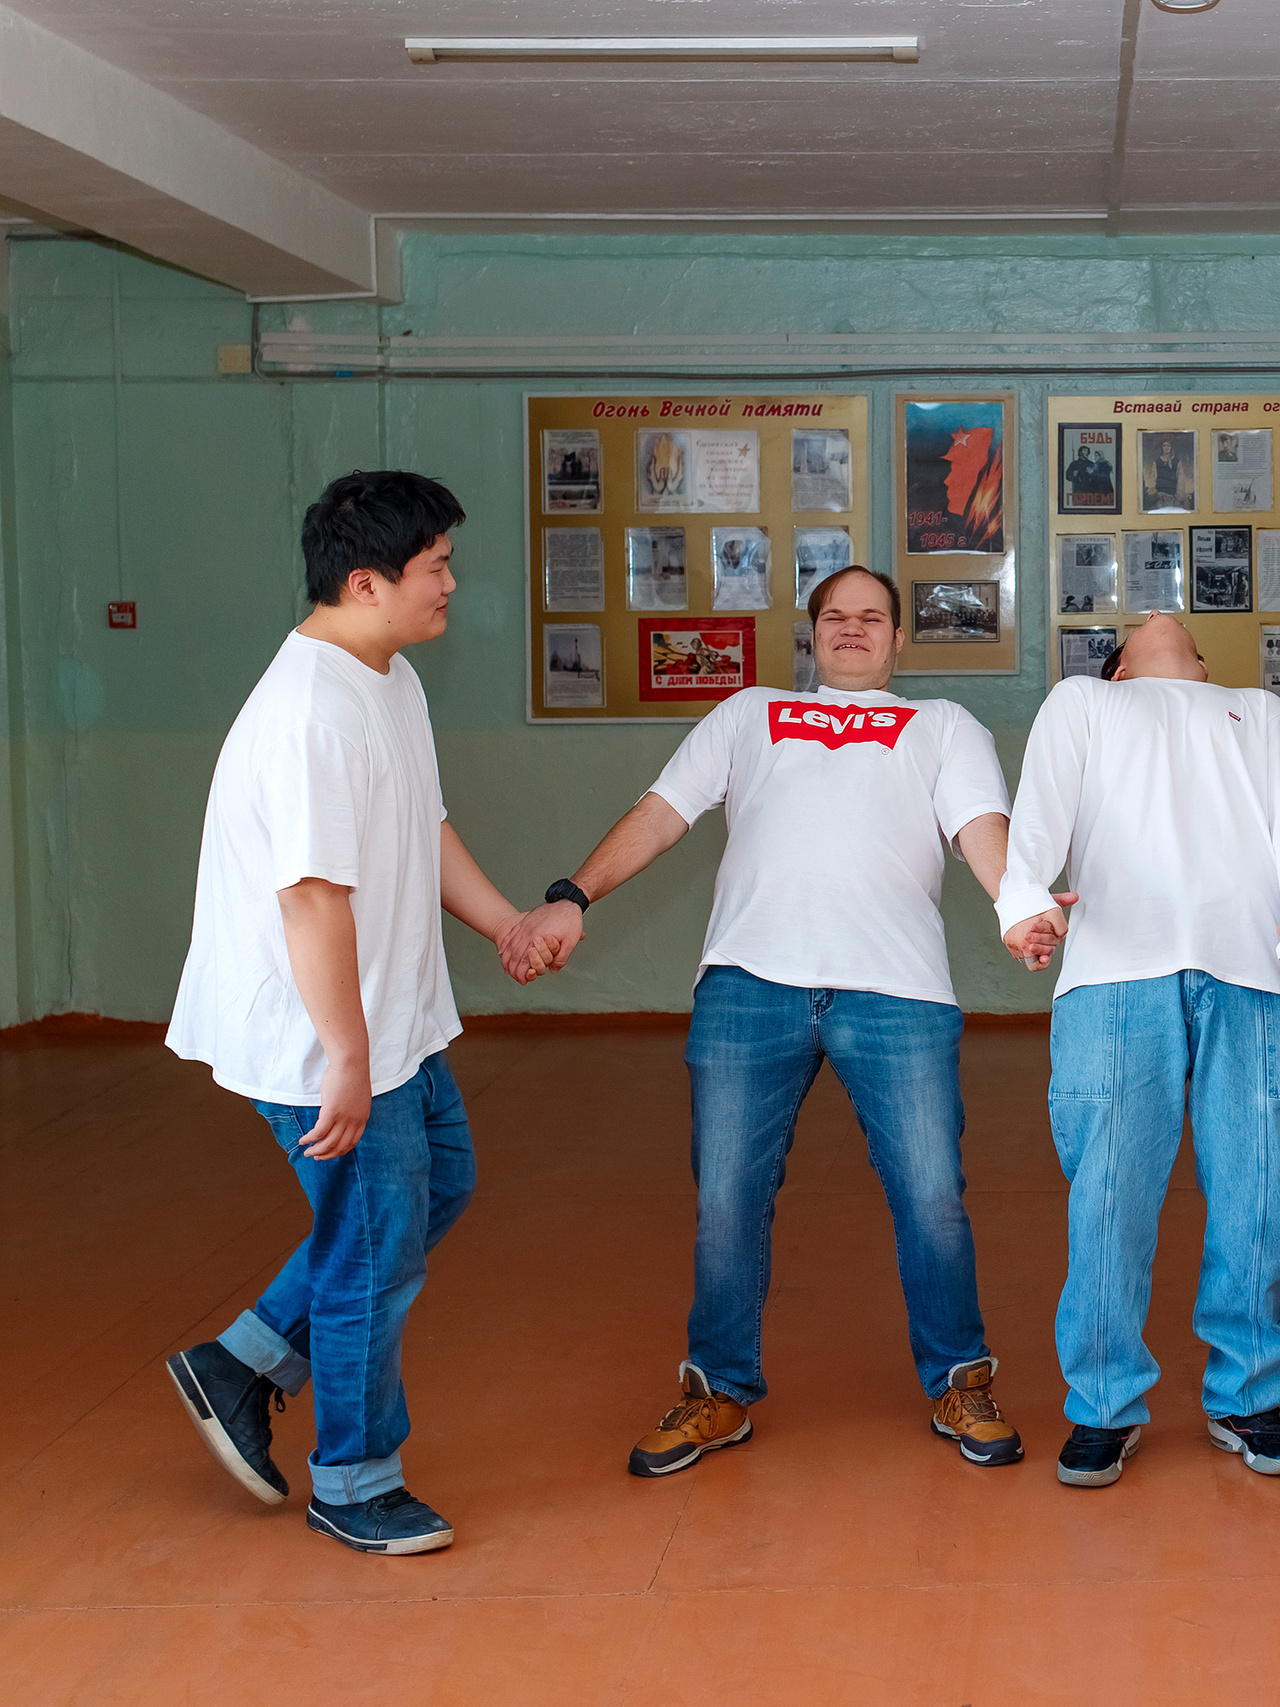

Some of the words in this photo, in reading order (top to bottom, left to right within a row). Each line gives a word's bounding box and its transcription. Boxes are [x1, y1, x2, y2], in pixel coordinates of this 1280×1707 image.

[592, 401, 650, 418] Огонь
[659, 399, 732, 417] Вечной
[741, 403, 823, 417] памяти
[1113, 400, 1182, 413] Вставай
[1191, 402, 1249, 415] страна
[1080, 432, 1113, 444] БУДЬ
[919, 532, 955, 548] 1945
[655, 675, 662, 685] С
